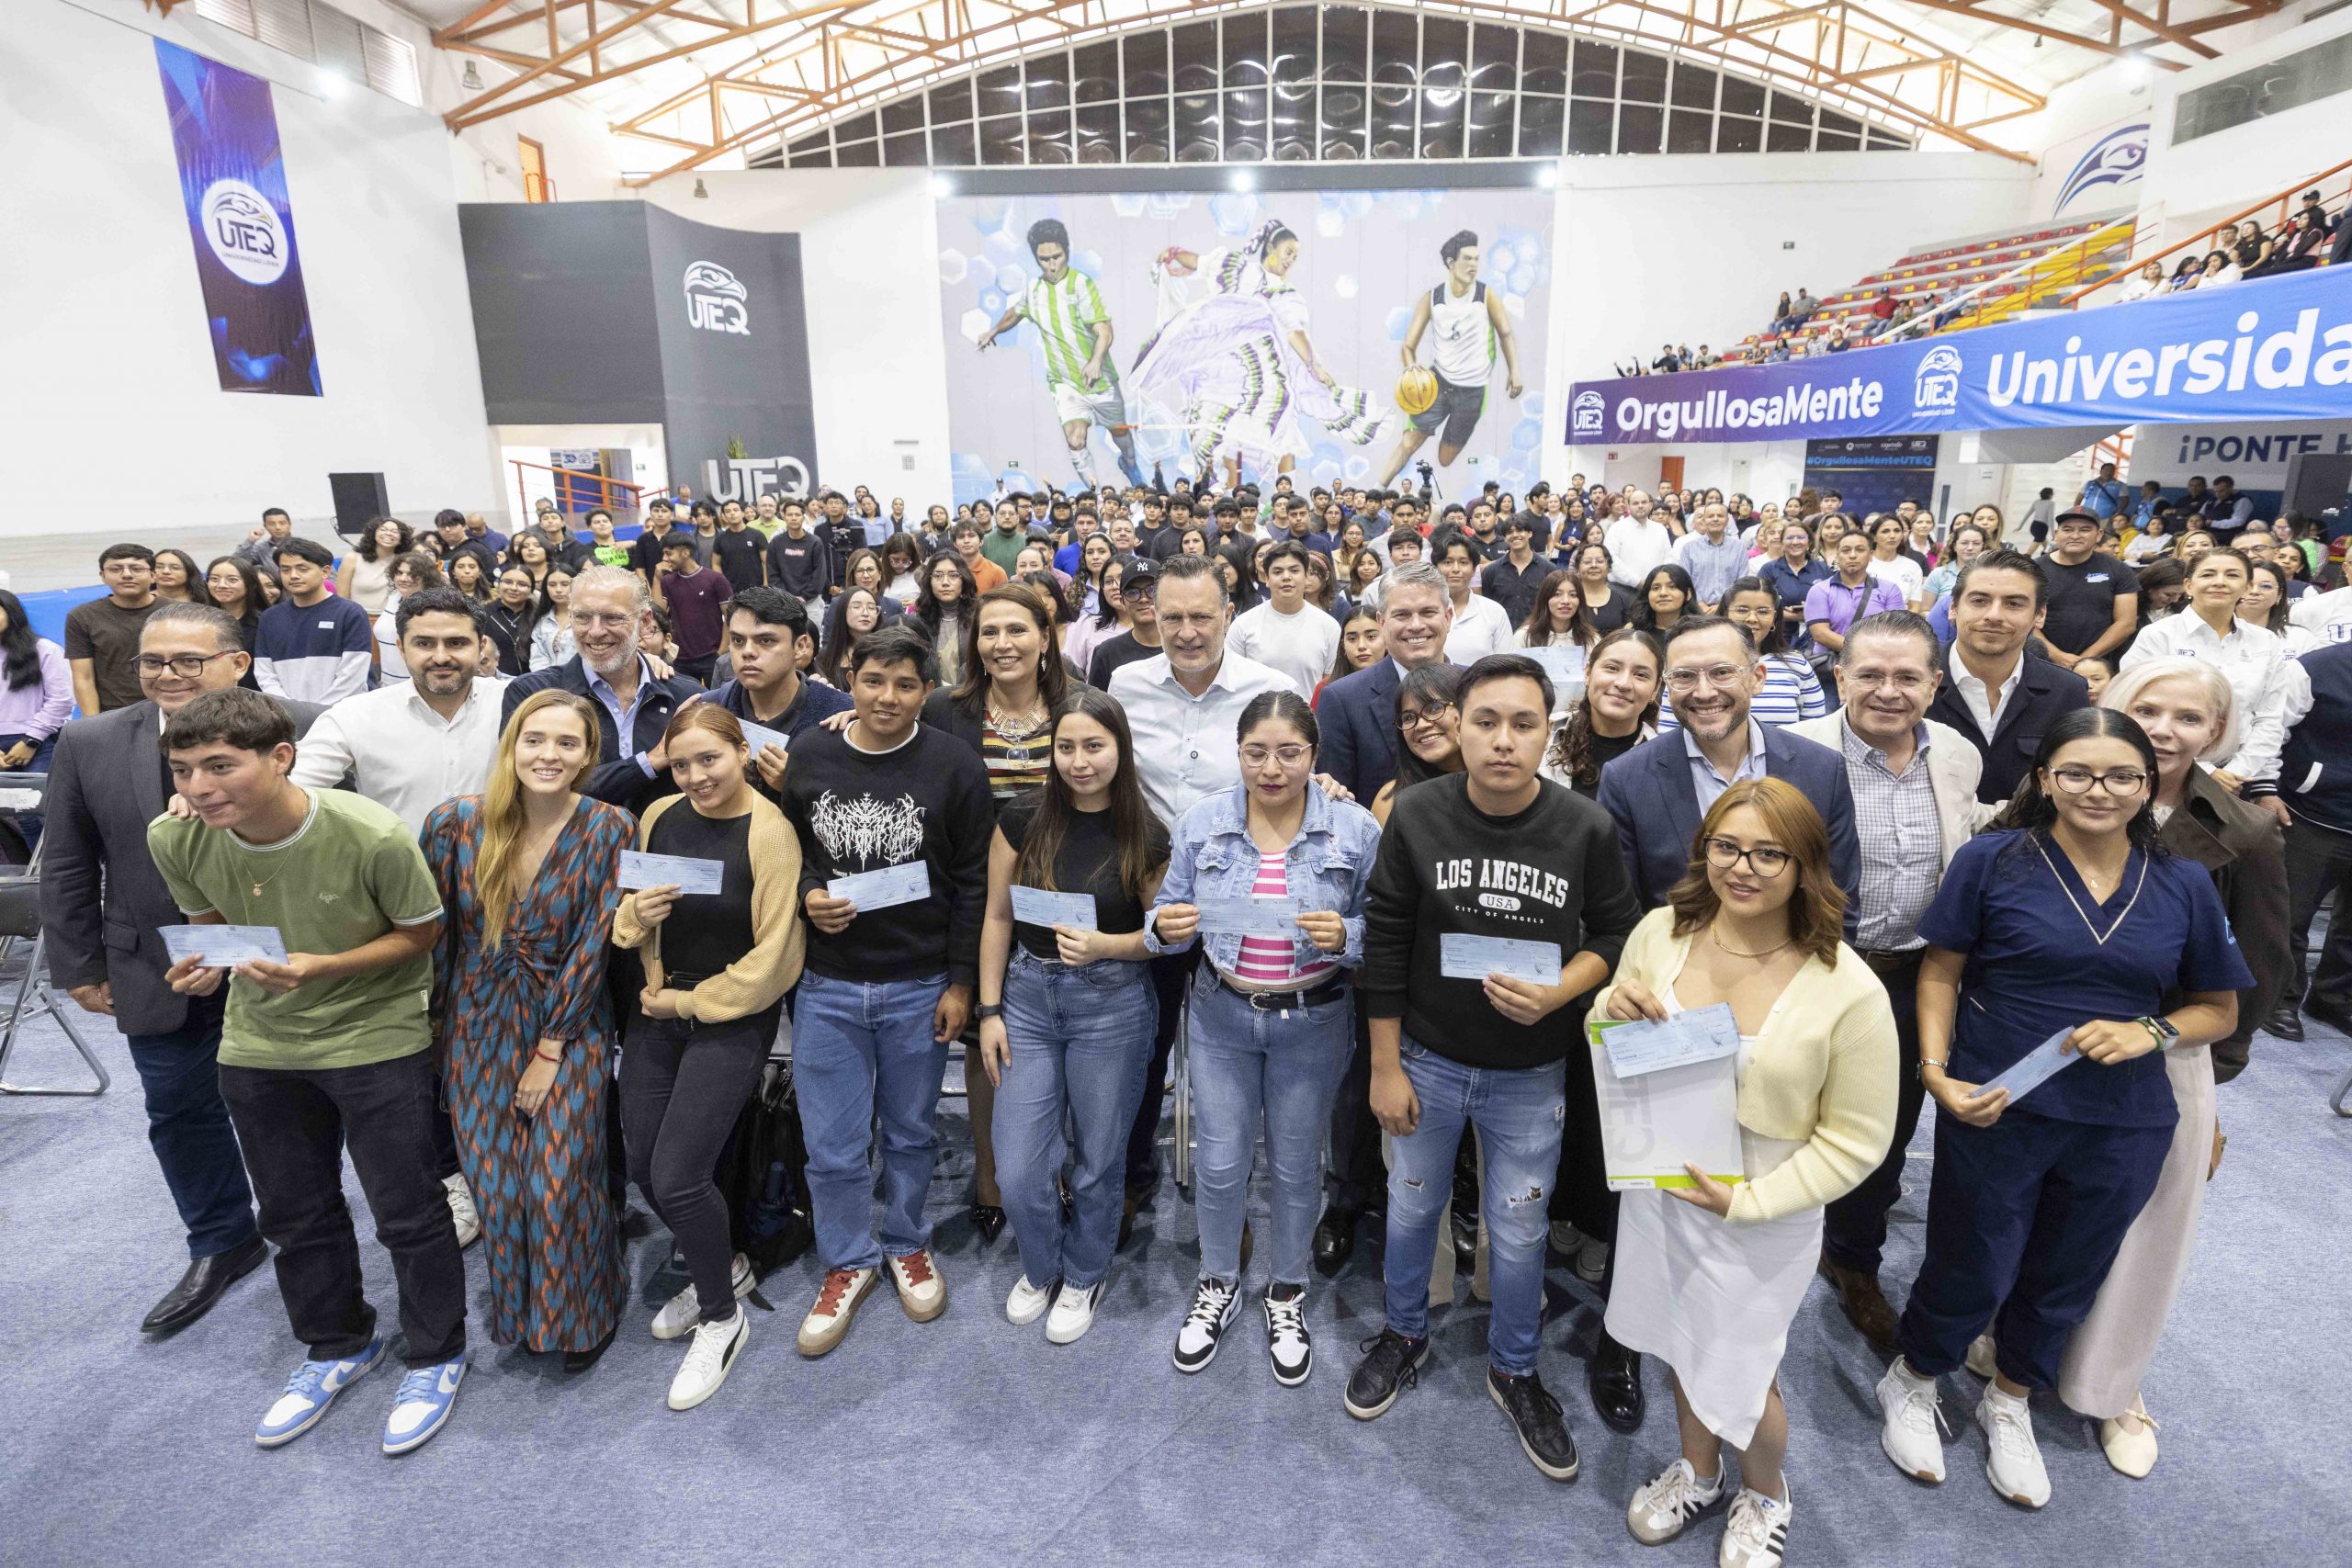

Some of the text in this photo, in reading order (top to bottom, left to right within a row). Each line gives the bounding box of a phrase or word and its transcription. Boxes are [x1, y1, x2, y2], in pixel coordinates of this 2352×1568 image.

[217, 217, 277, 259] UTEQ
[686, 292, 752, 335] UTEQ
[1616, 377, 1883, 438] OrgullosaMente
[1915, 374, 1959, 408] UTEQ
[1573, 410, 1603, 430] UTEQ
[1436, 858, 1569, 909] LOS ANGELES
[1455, 905, 1478, 915] CITY
[1505, 913, 1544, 924] ANGELS
[1487, 896, 1514, 910] USA
